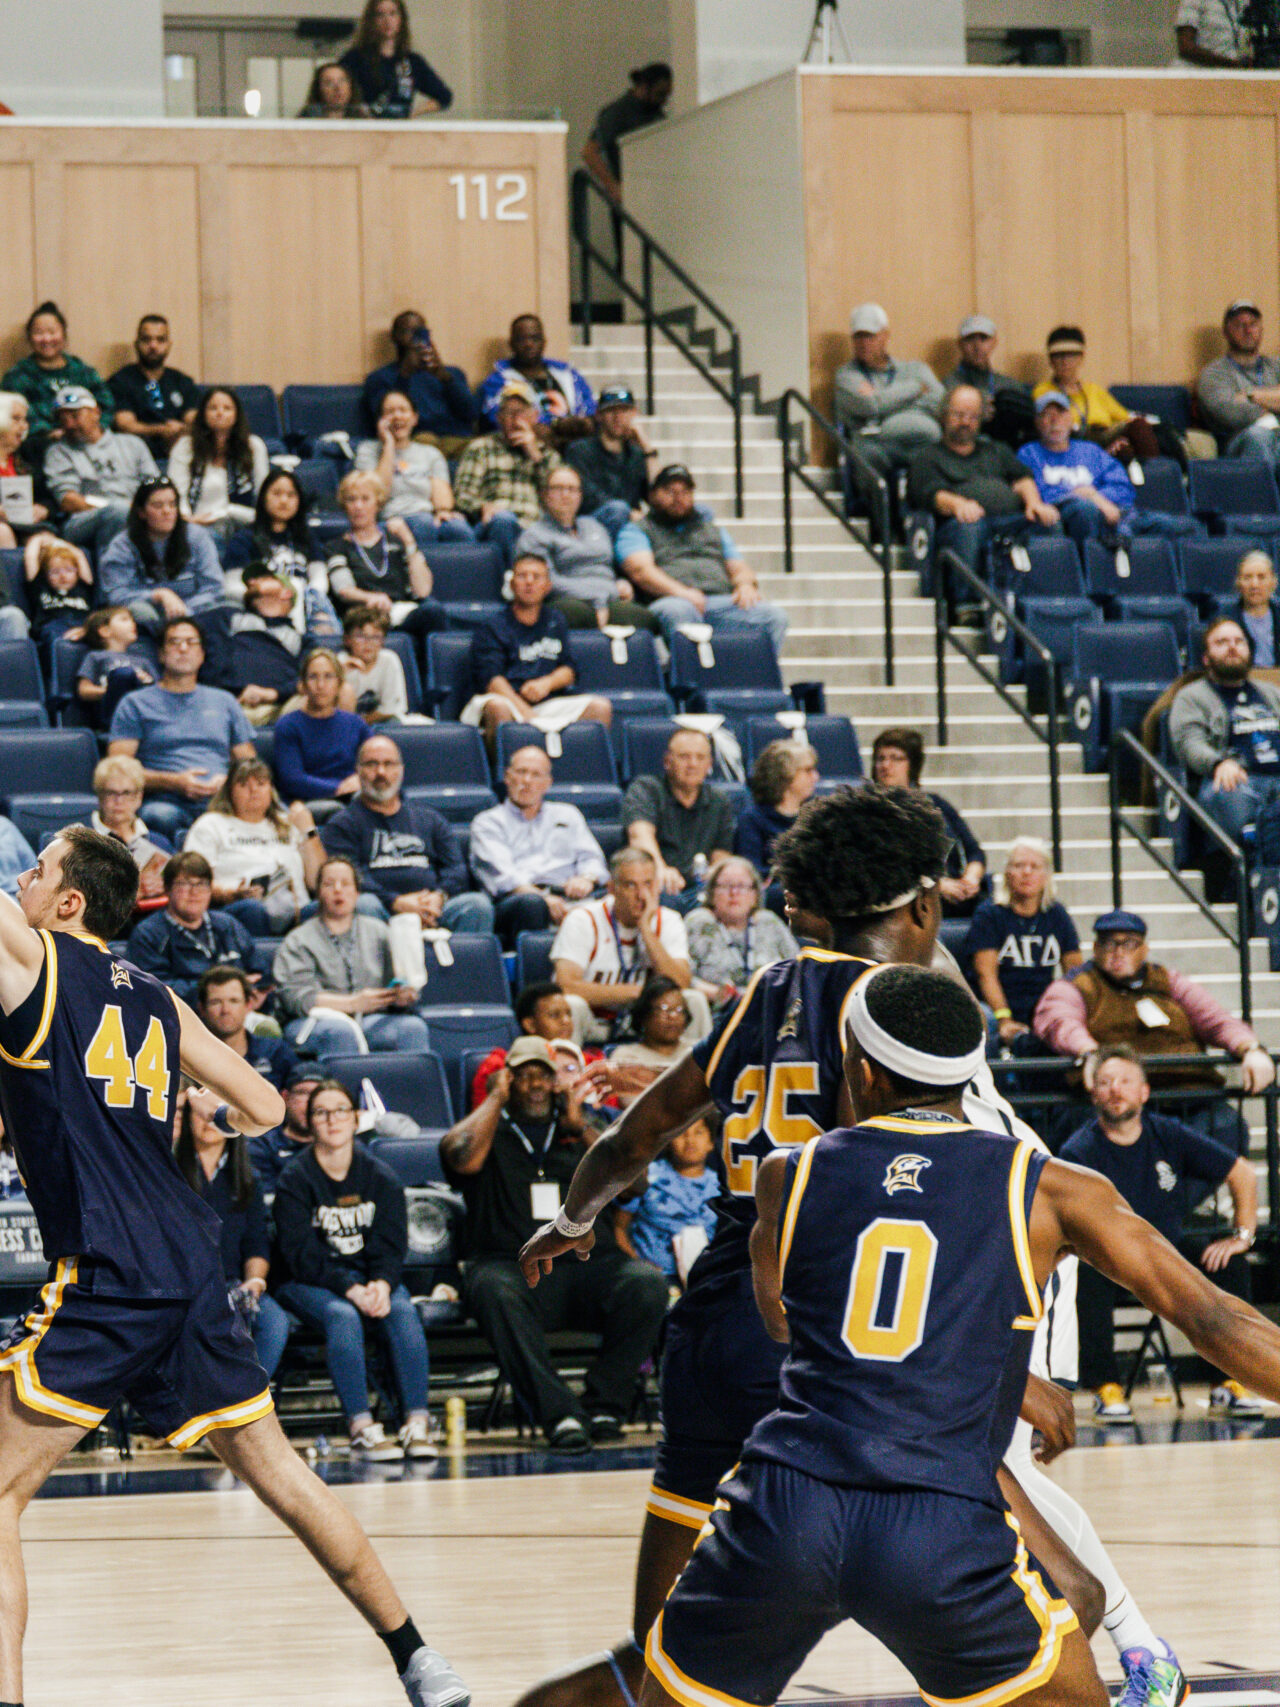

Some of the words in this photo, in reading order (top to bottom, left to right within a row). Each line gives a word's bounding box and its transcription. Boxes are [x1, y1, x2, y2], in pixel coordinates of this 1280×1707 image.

[449, 173, 529, 220] 112
[84, 1003, 171, 1123] 44
[722, 1061, 825, 1197] 25
[840, 1217, 939, 1363] 0
